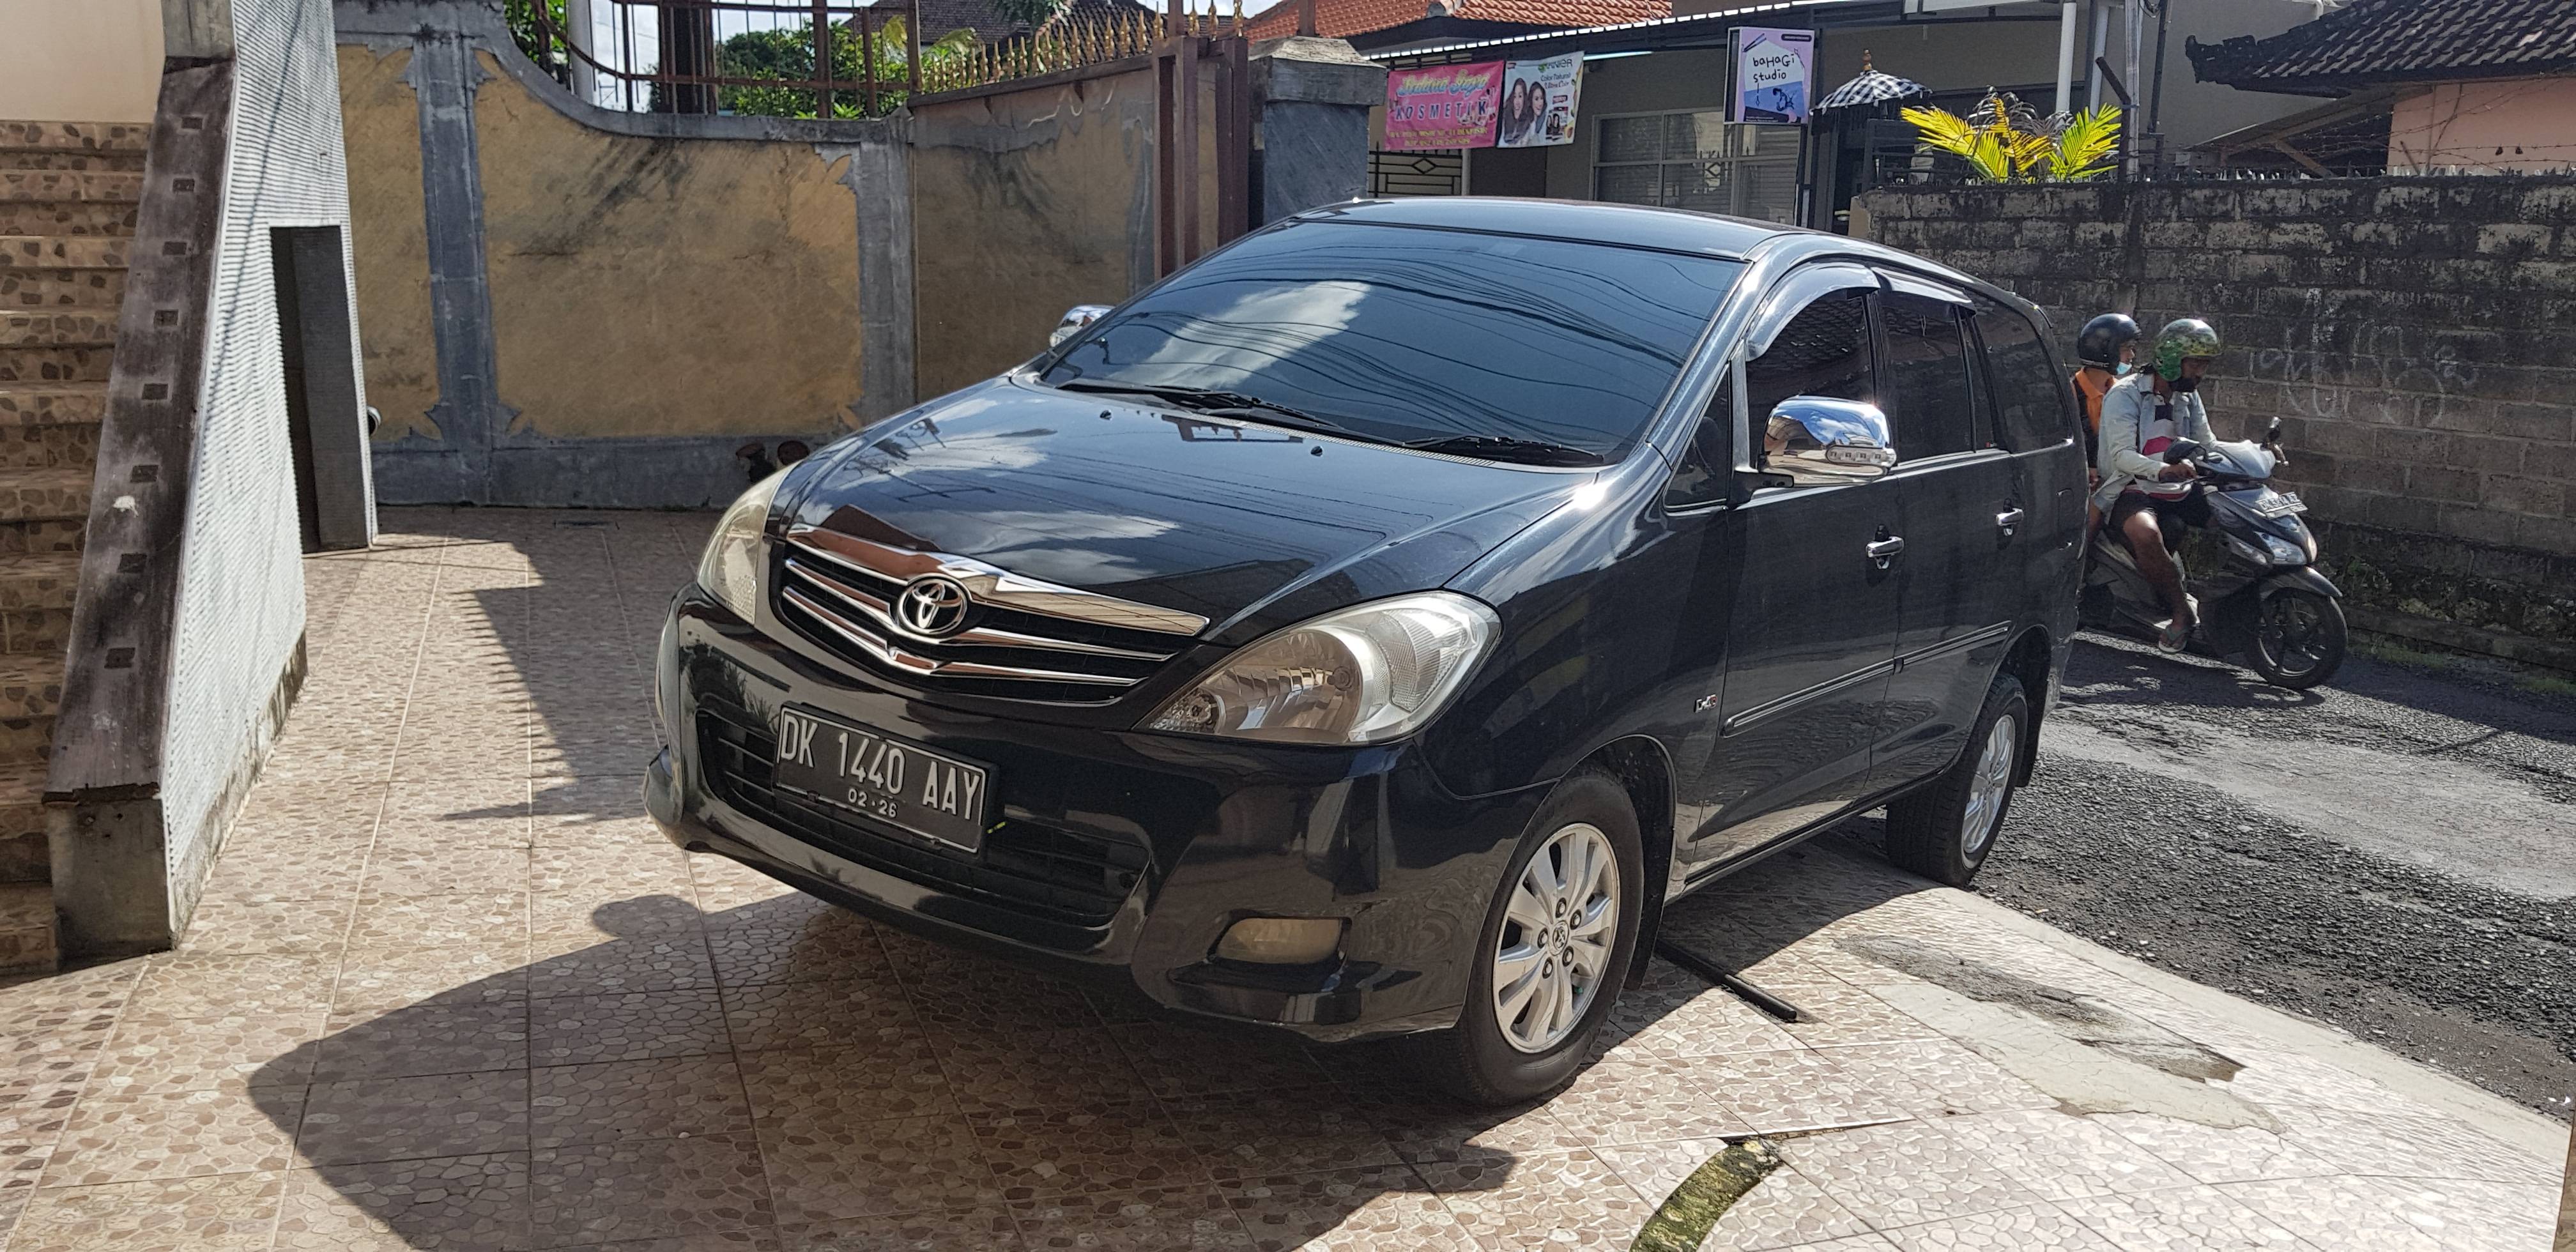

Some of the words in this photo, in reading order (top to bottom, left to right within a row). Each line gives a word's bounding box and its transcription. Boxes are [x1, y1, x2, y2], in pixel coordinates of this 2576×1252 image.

[1753, 69, 1786, 83] studio
[780, 714, 819, 769] DK
[838, 731, 907, 795] 1440
[922, 760, 981, 821] AAY
